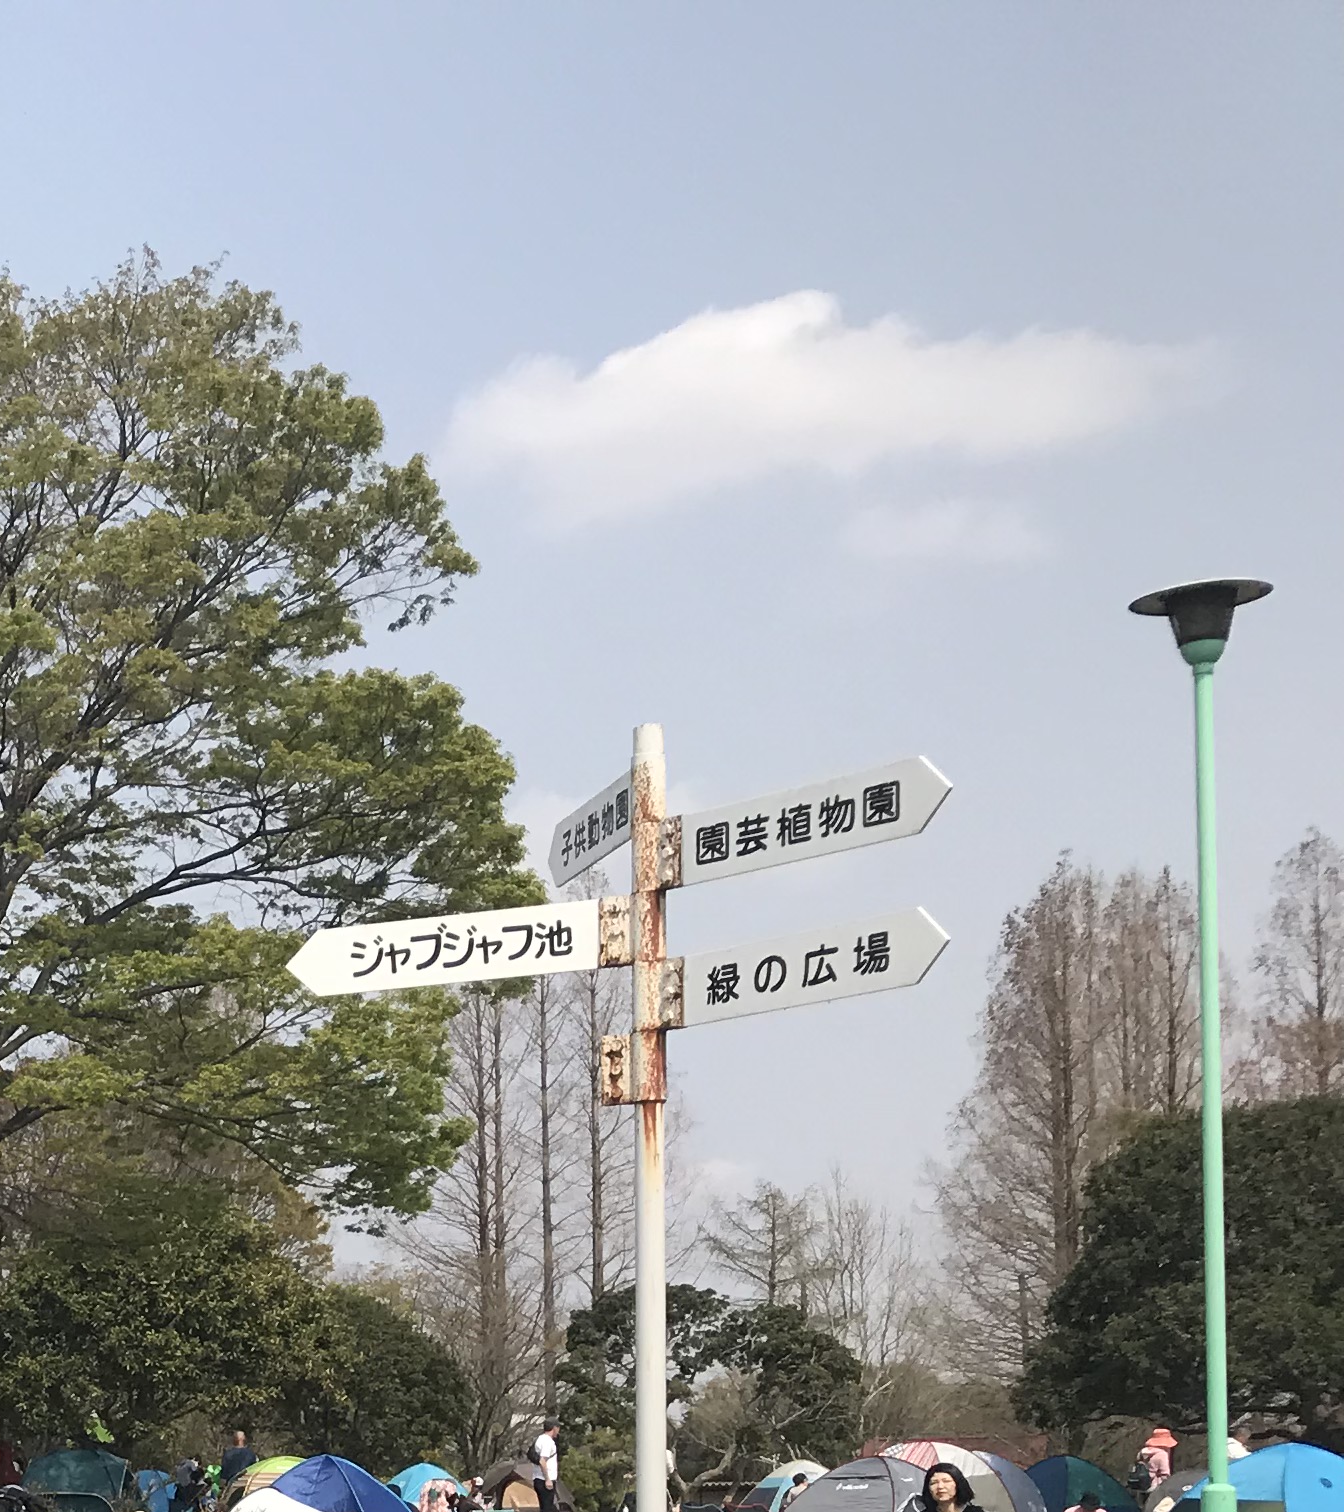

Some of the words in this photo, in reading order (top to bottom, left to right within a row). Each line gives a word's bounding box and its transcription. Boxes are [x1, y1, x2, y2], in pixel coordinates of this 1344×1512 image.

[696, 780, 900, 865] 園芸植物園
[706, 931, 890, 1005] 緑の広場
